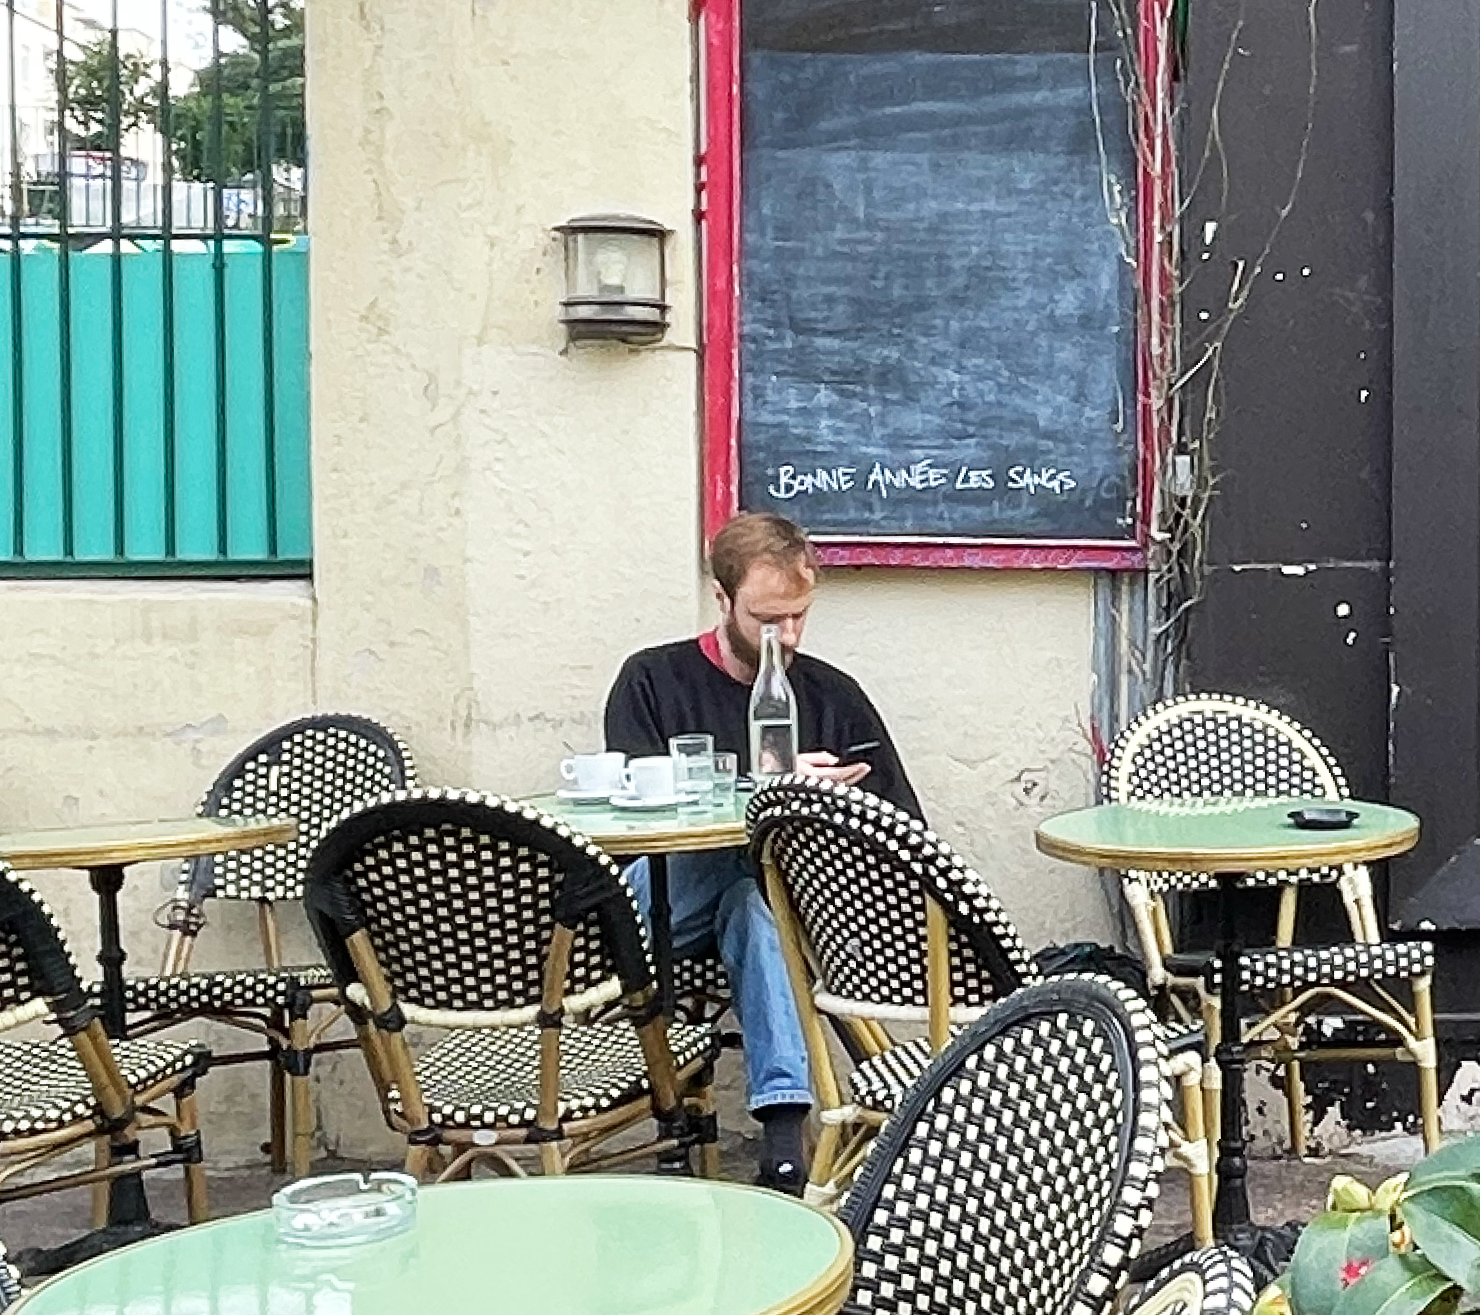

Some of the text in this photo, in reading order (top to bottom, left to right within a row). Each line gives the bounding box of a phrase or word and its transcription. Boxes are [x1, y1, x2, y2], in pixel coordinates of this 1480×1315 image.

[768, 459, 1077, 499] BONNE ANNÉE LES SANGS
